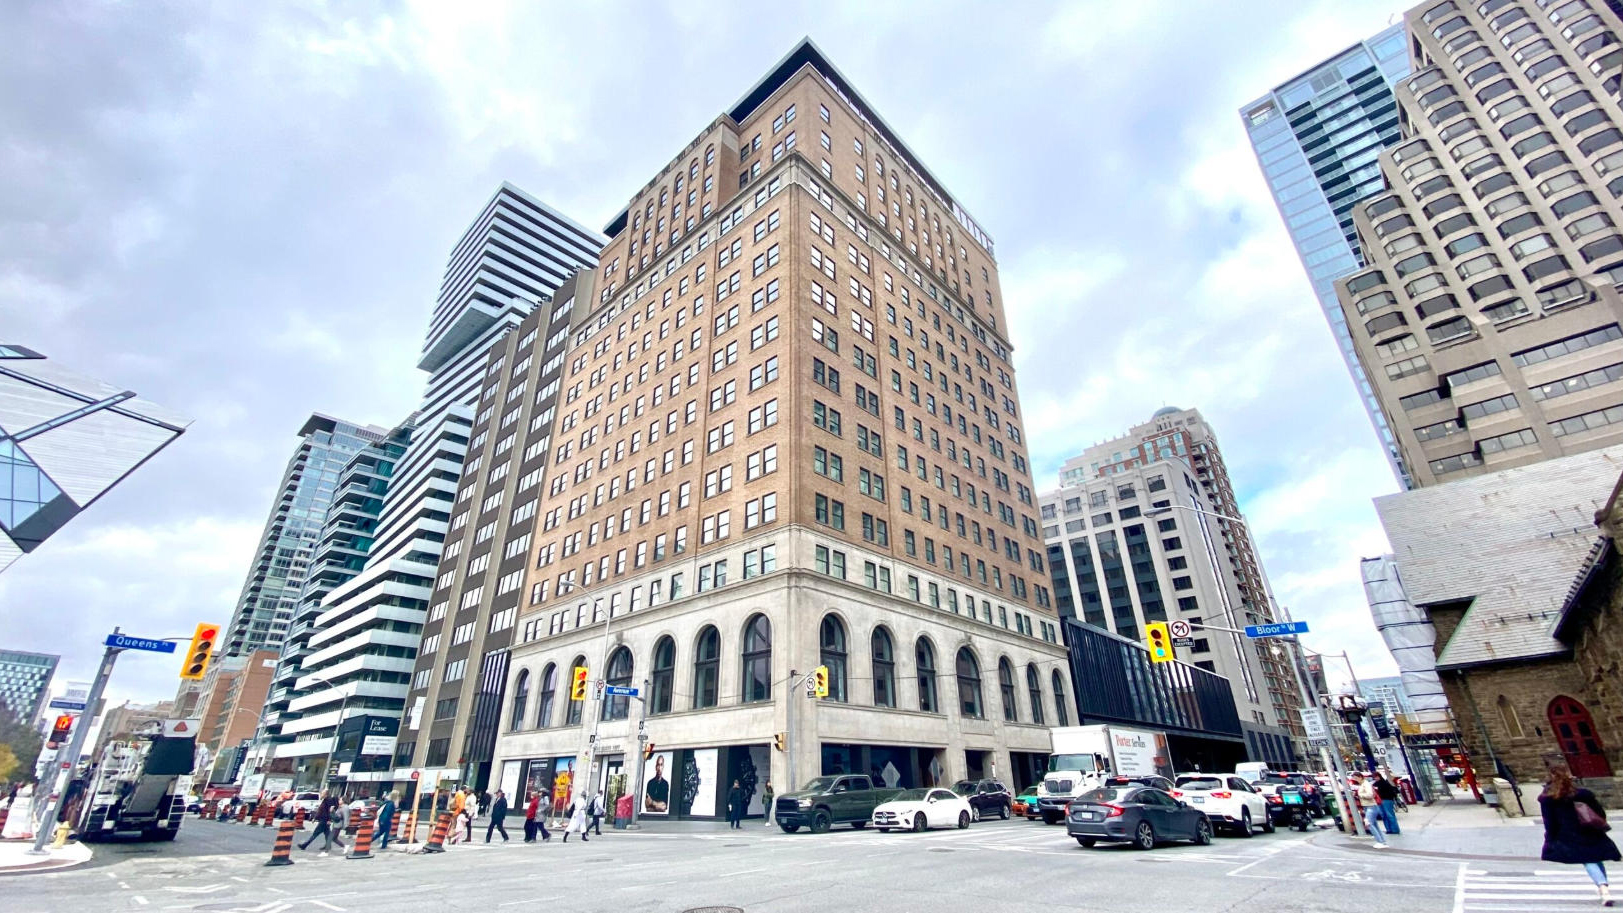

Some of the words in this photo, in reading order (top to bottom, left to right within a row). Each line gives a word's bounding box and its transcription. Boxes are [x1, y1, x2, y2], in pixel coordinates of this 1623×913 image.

[1256, 626, 1280, 635] Bloor
[1286, 623, 1296, 632] W
[115, 636, 158, 649] Queens
